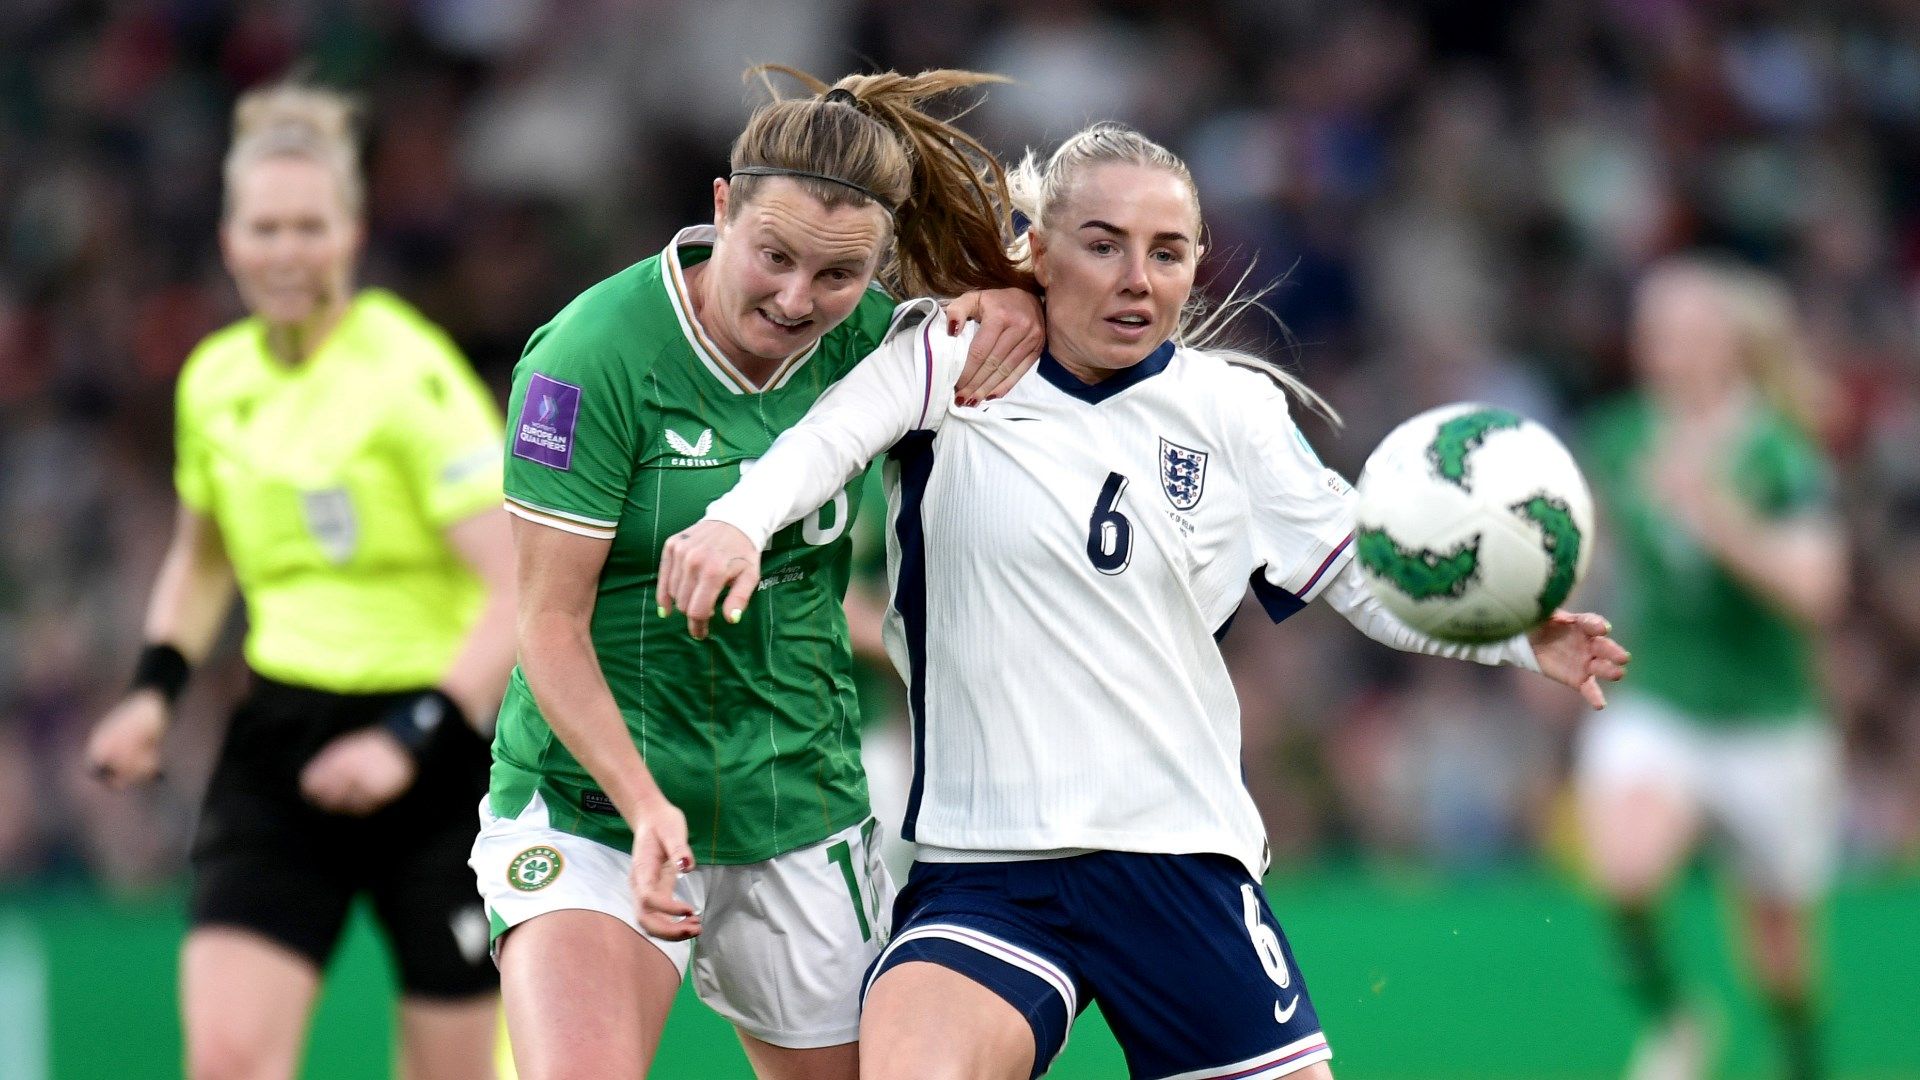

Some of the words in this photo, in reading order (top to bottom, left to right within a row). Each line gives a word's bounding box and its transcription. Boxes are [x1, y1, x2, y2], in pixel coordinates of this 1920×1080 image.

[520, 432, 567, 453] QUALIFIERS
[522, 424, 567, 444] EUROPEAN
[1086, 471, 1134, 576] 6
[781, 571, 804, 583] 2024
[1240, 883, 1290, 989] 6
